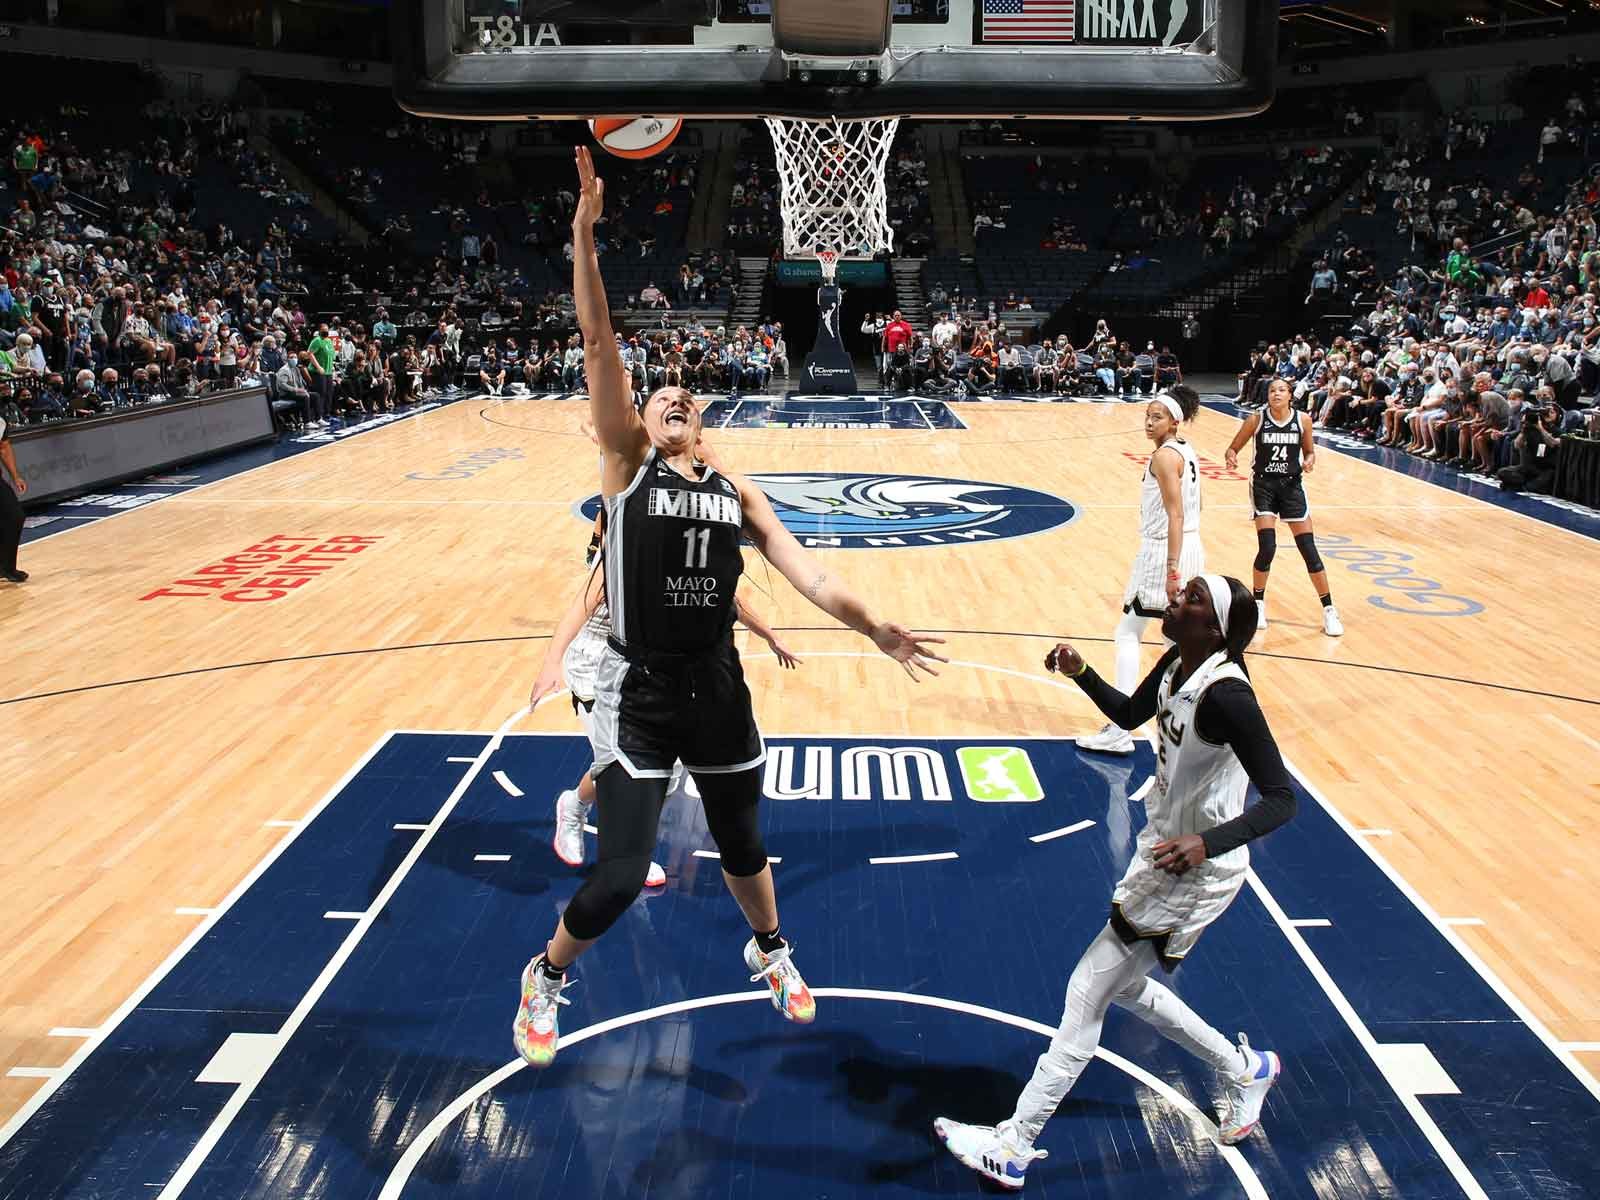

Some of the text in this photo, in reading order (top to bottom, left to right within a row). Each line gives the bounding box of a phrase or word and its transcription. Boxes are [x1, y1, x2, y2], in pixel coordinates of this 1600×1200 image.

[1263, 432, 1299, 444] MINN
[1271, 446, 1288, 461] 24
[1189, 460, 1197, 483] 3
[650, 488, 742, 528] MINN
[683, 527, 710, 569] 11
[138, 534, 319, 601] TARGET
[220, 535, 385, 603] CENTER
[665, 576, 717, 592] MAYO
[663, 592, 720, 607] CLINIC
